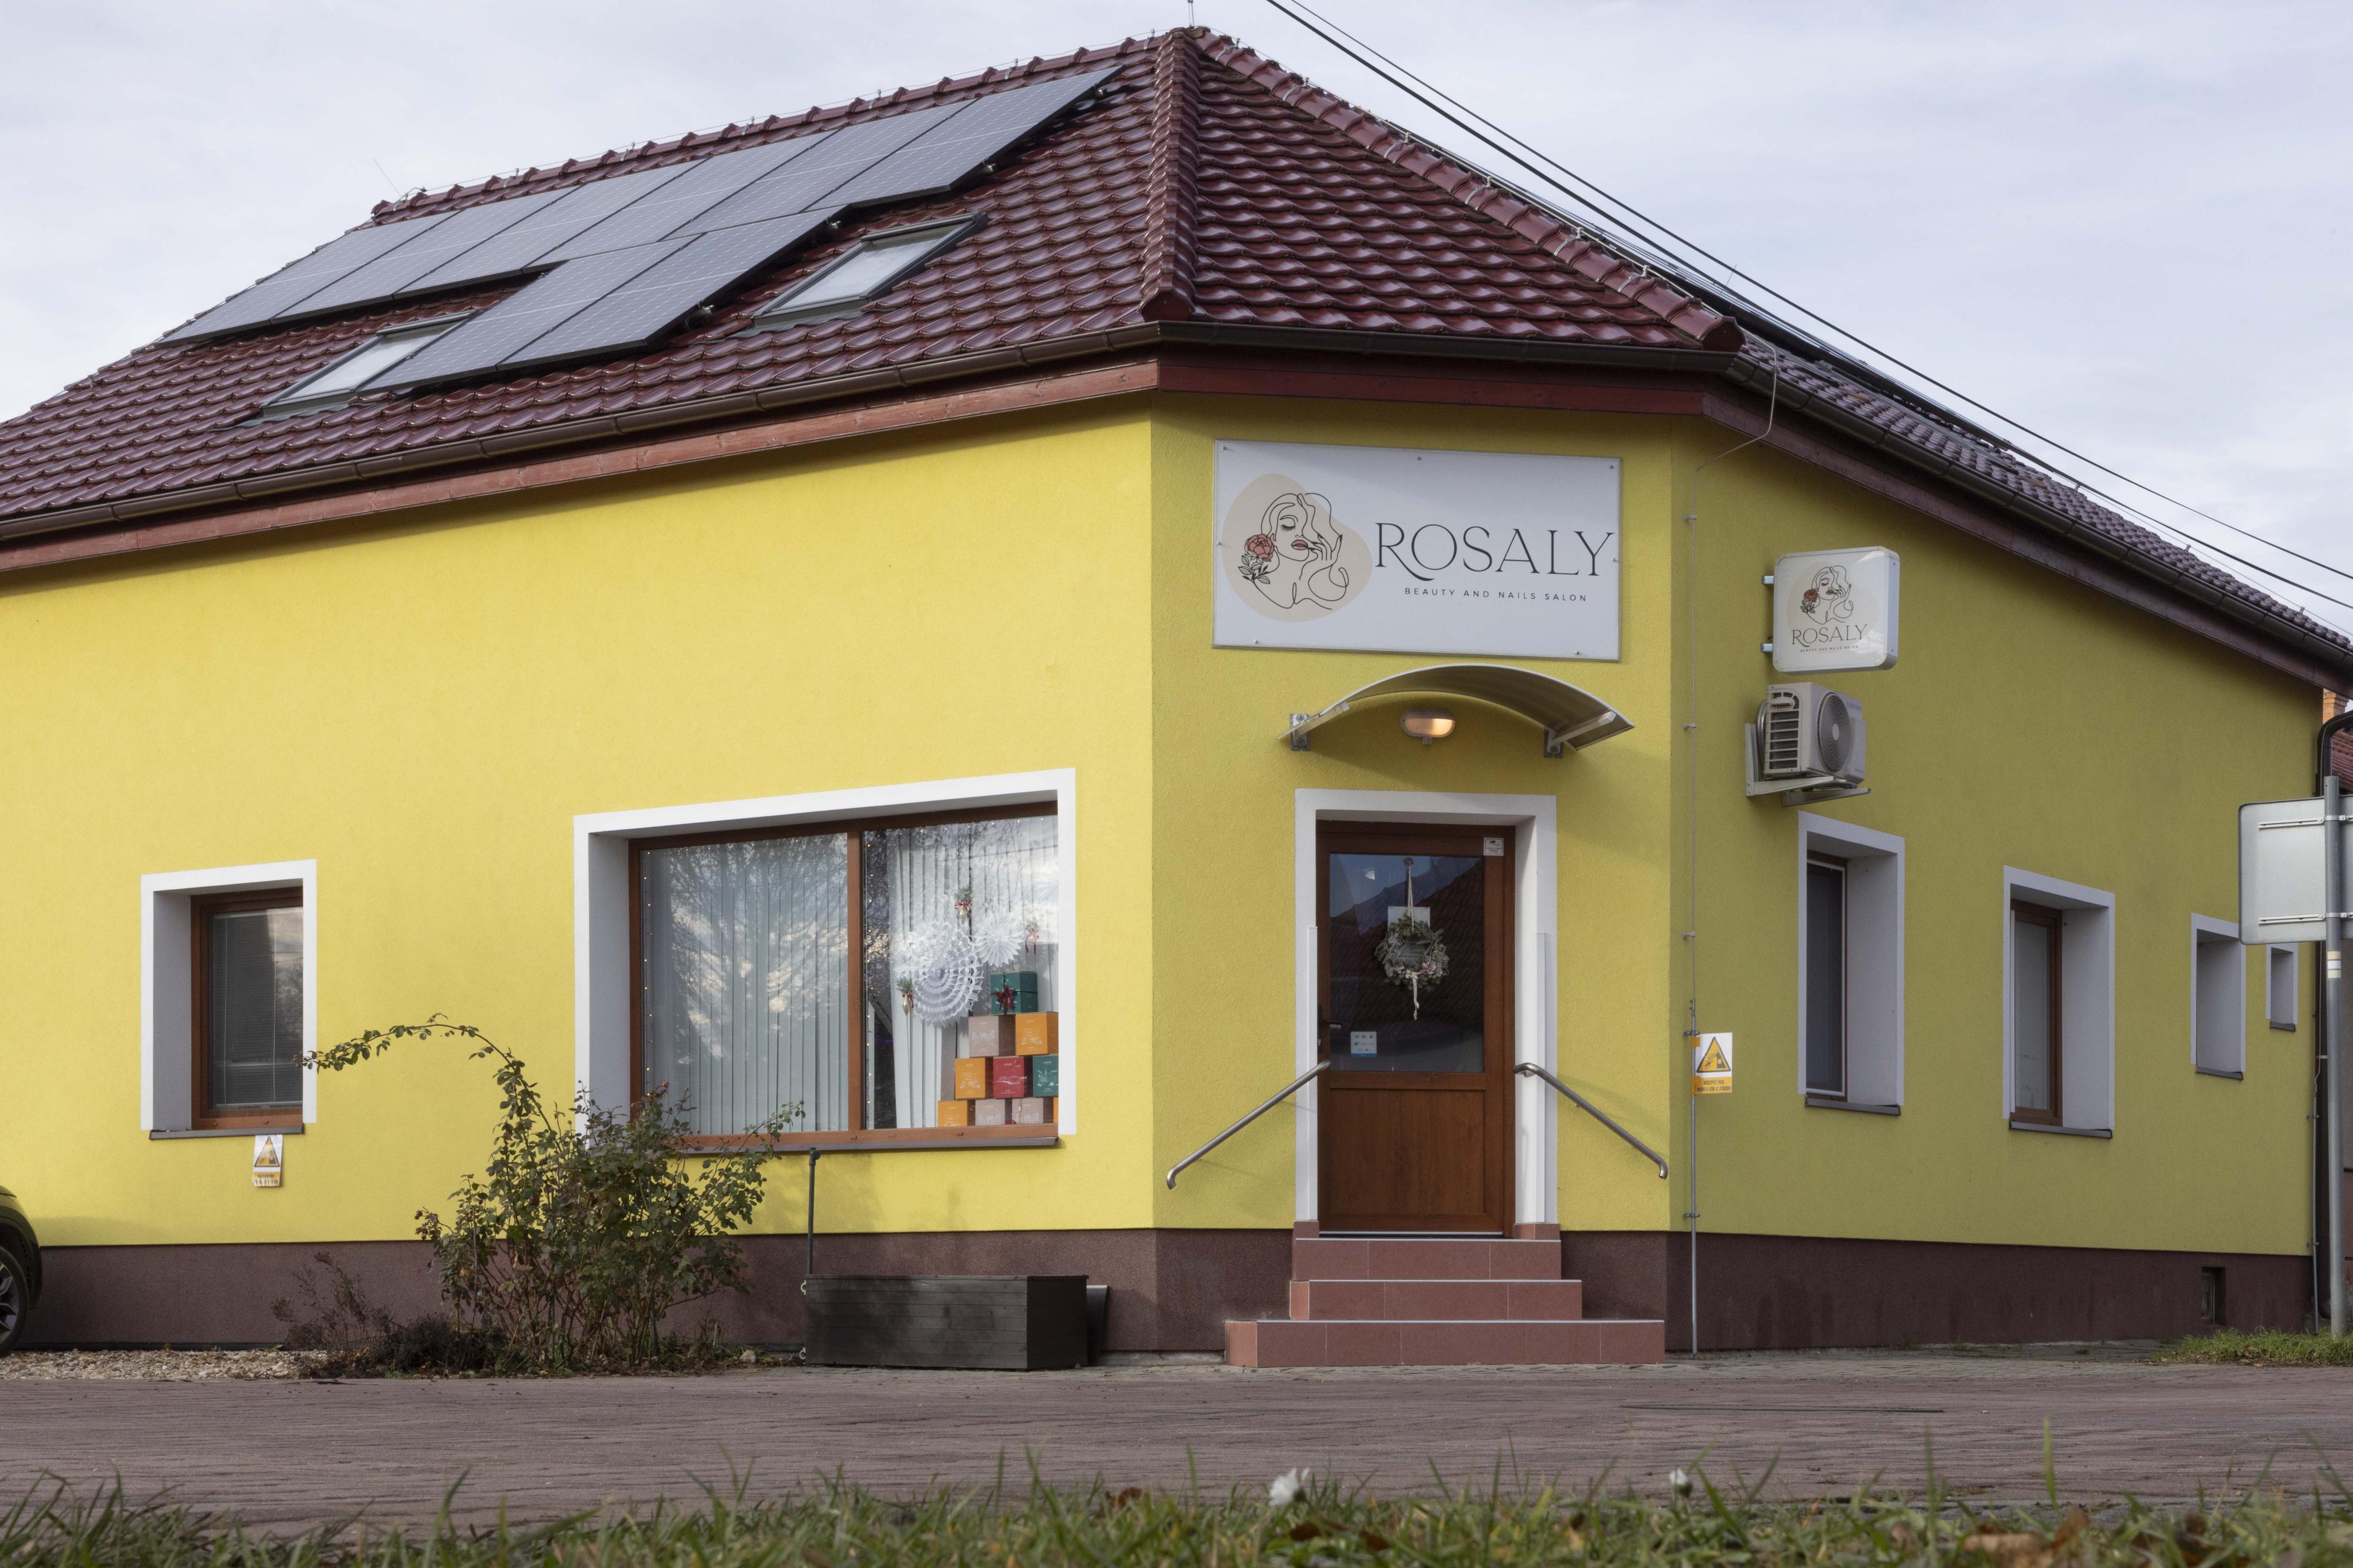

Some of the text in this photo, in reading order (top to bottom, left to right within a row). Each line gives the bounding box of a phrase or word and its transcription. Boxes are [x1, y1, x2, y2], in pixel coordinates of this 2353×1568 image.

[1374, 522, 1616, 582] ROSALY
[1404, 588, 1455, 596] BEAUTY
[1498, 591, 1536, 599] NAILS
[1544, 593, 1586, 602] SALON
[1792, 623, 1868, 648] ROSALY
